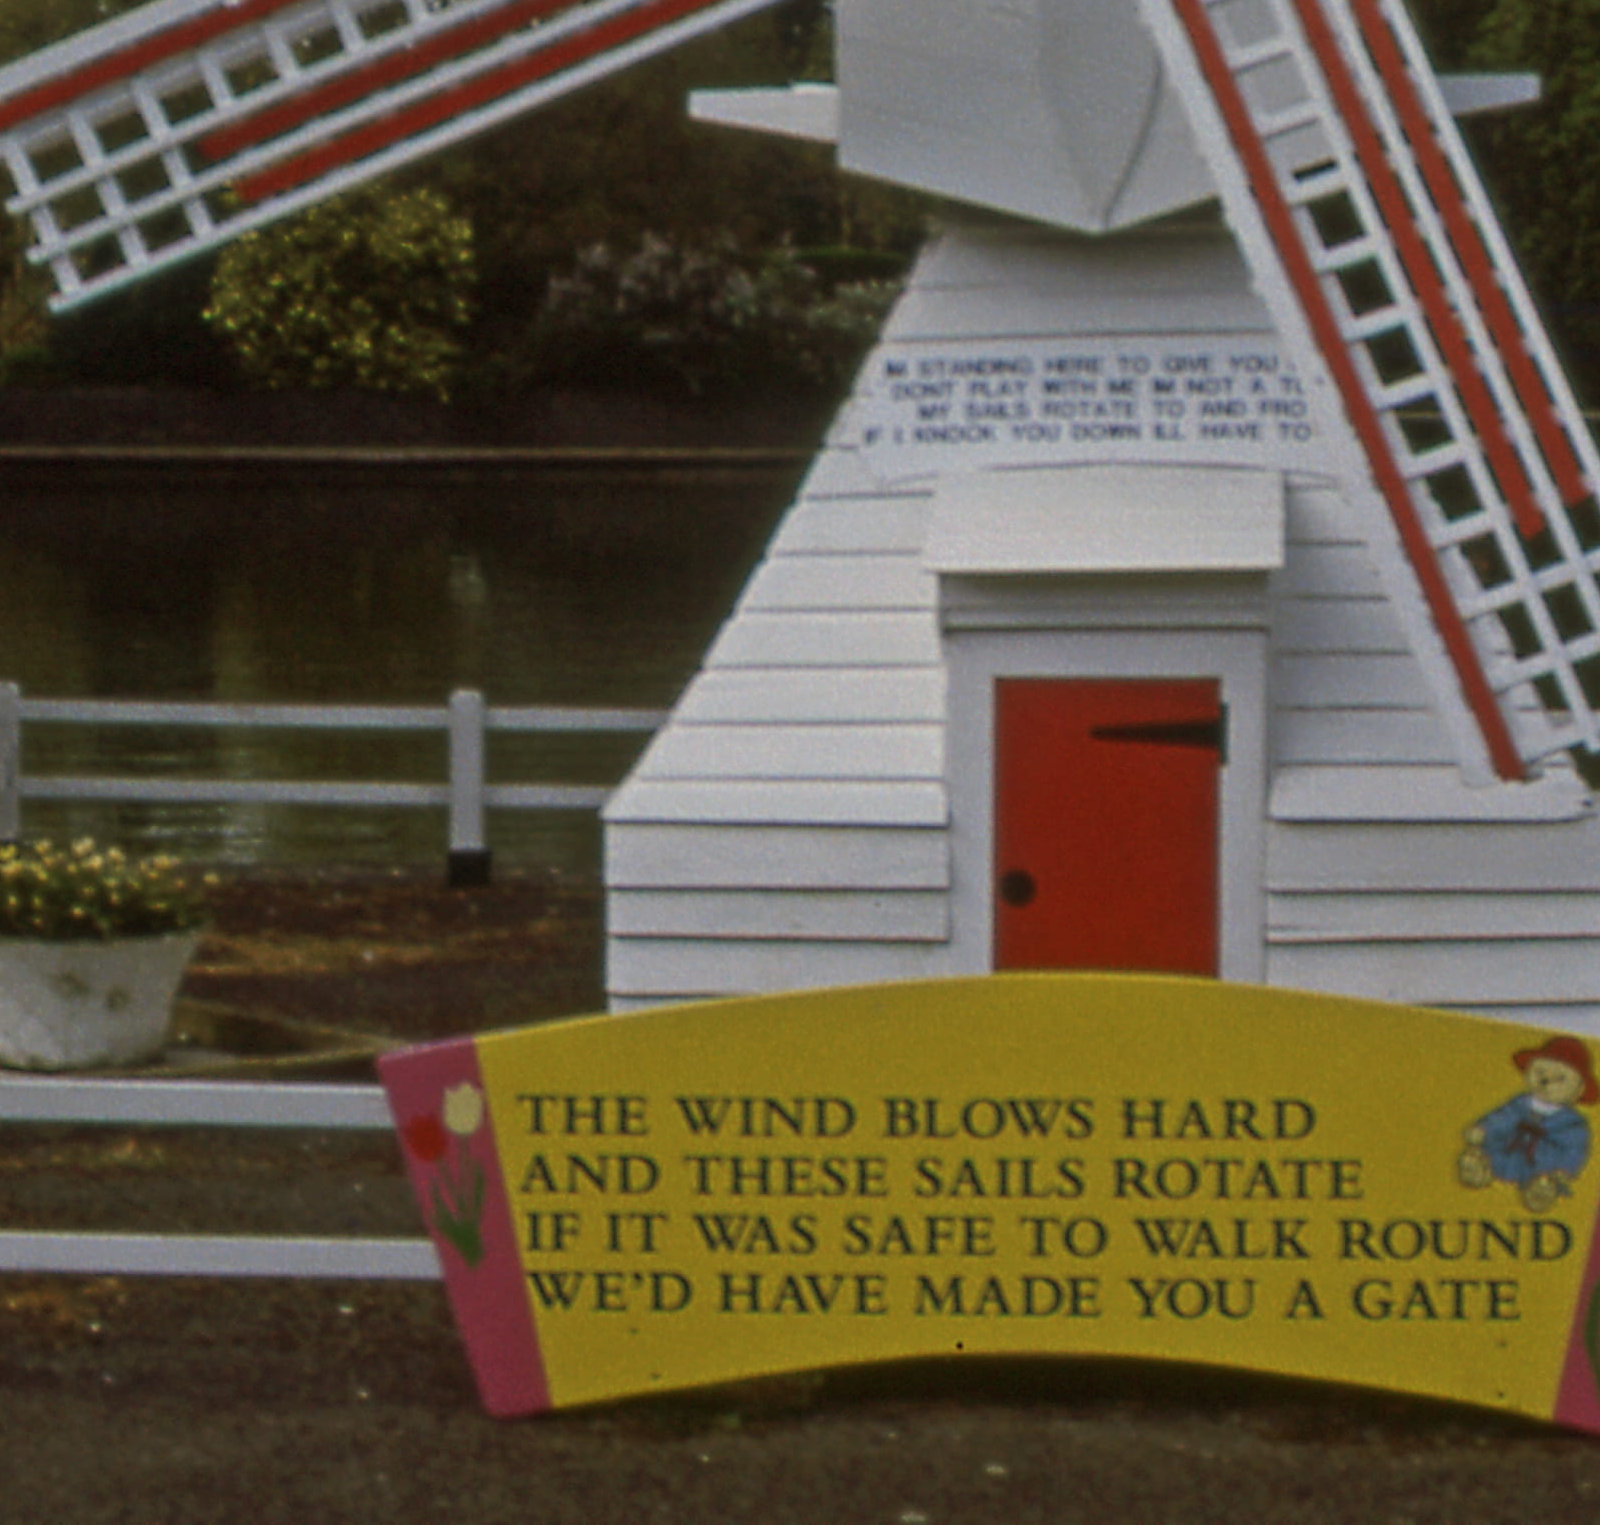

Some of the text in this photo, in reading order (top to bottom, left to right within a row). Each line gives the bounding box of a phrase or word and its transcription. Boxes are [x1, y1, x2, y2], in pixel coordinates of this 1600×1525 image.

[917, 356, 1033, 376] STANDING
[1043, 354, 1103, 373] HERE
[1117, 353, 1151, 373] TO
[1163, 353, 1210, 372] GIVE
[1227, 352, 1279, 372] YOU
[967, 379, 1027, 397] PLAY
[1042, 379, 1096, 395] WITH
[1108, 378, 1133, 394] ME
[1186, 377, 1233, 394] NOT
[1250, 377, 1266, 394] A
[917, 398, 1309, 420] MY SAILS ROTATE TO AND FRO
[864, 426, 882, 445] IF
[913, 424, 997, 443] KNOCK
[1011, 423, 1062, 443] YOU
[1071, 422, 1141, 441] DOWN
[1200, 422, 1259, 441] HAVE
[1277, 421, 1312, 442] TO
[518, 1094, 1317, 1141] THE WIND BLOWS HARD
[521, 1154, 1365, 1201] AND THESE SAILS ROTATE
[525, 1212, 1573, 1261] IF IT WAS SAFE TO WALK ROUND
[525, 1271, 1522, 1321] WE'D HAVE MADE YOU A GATE
